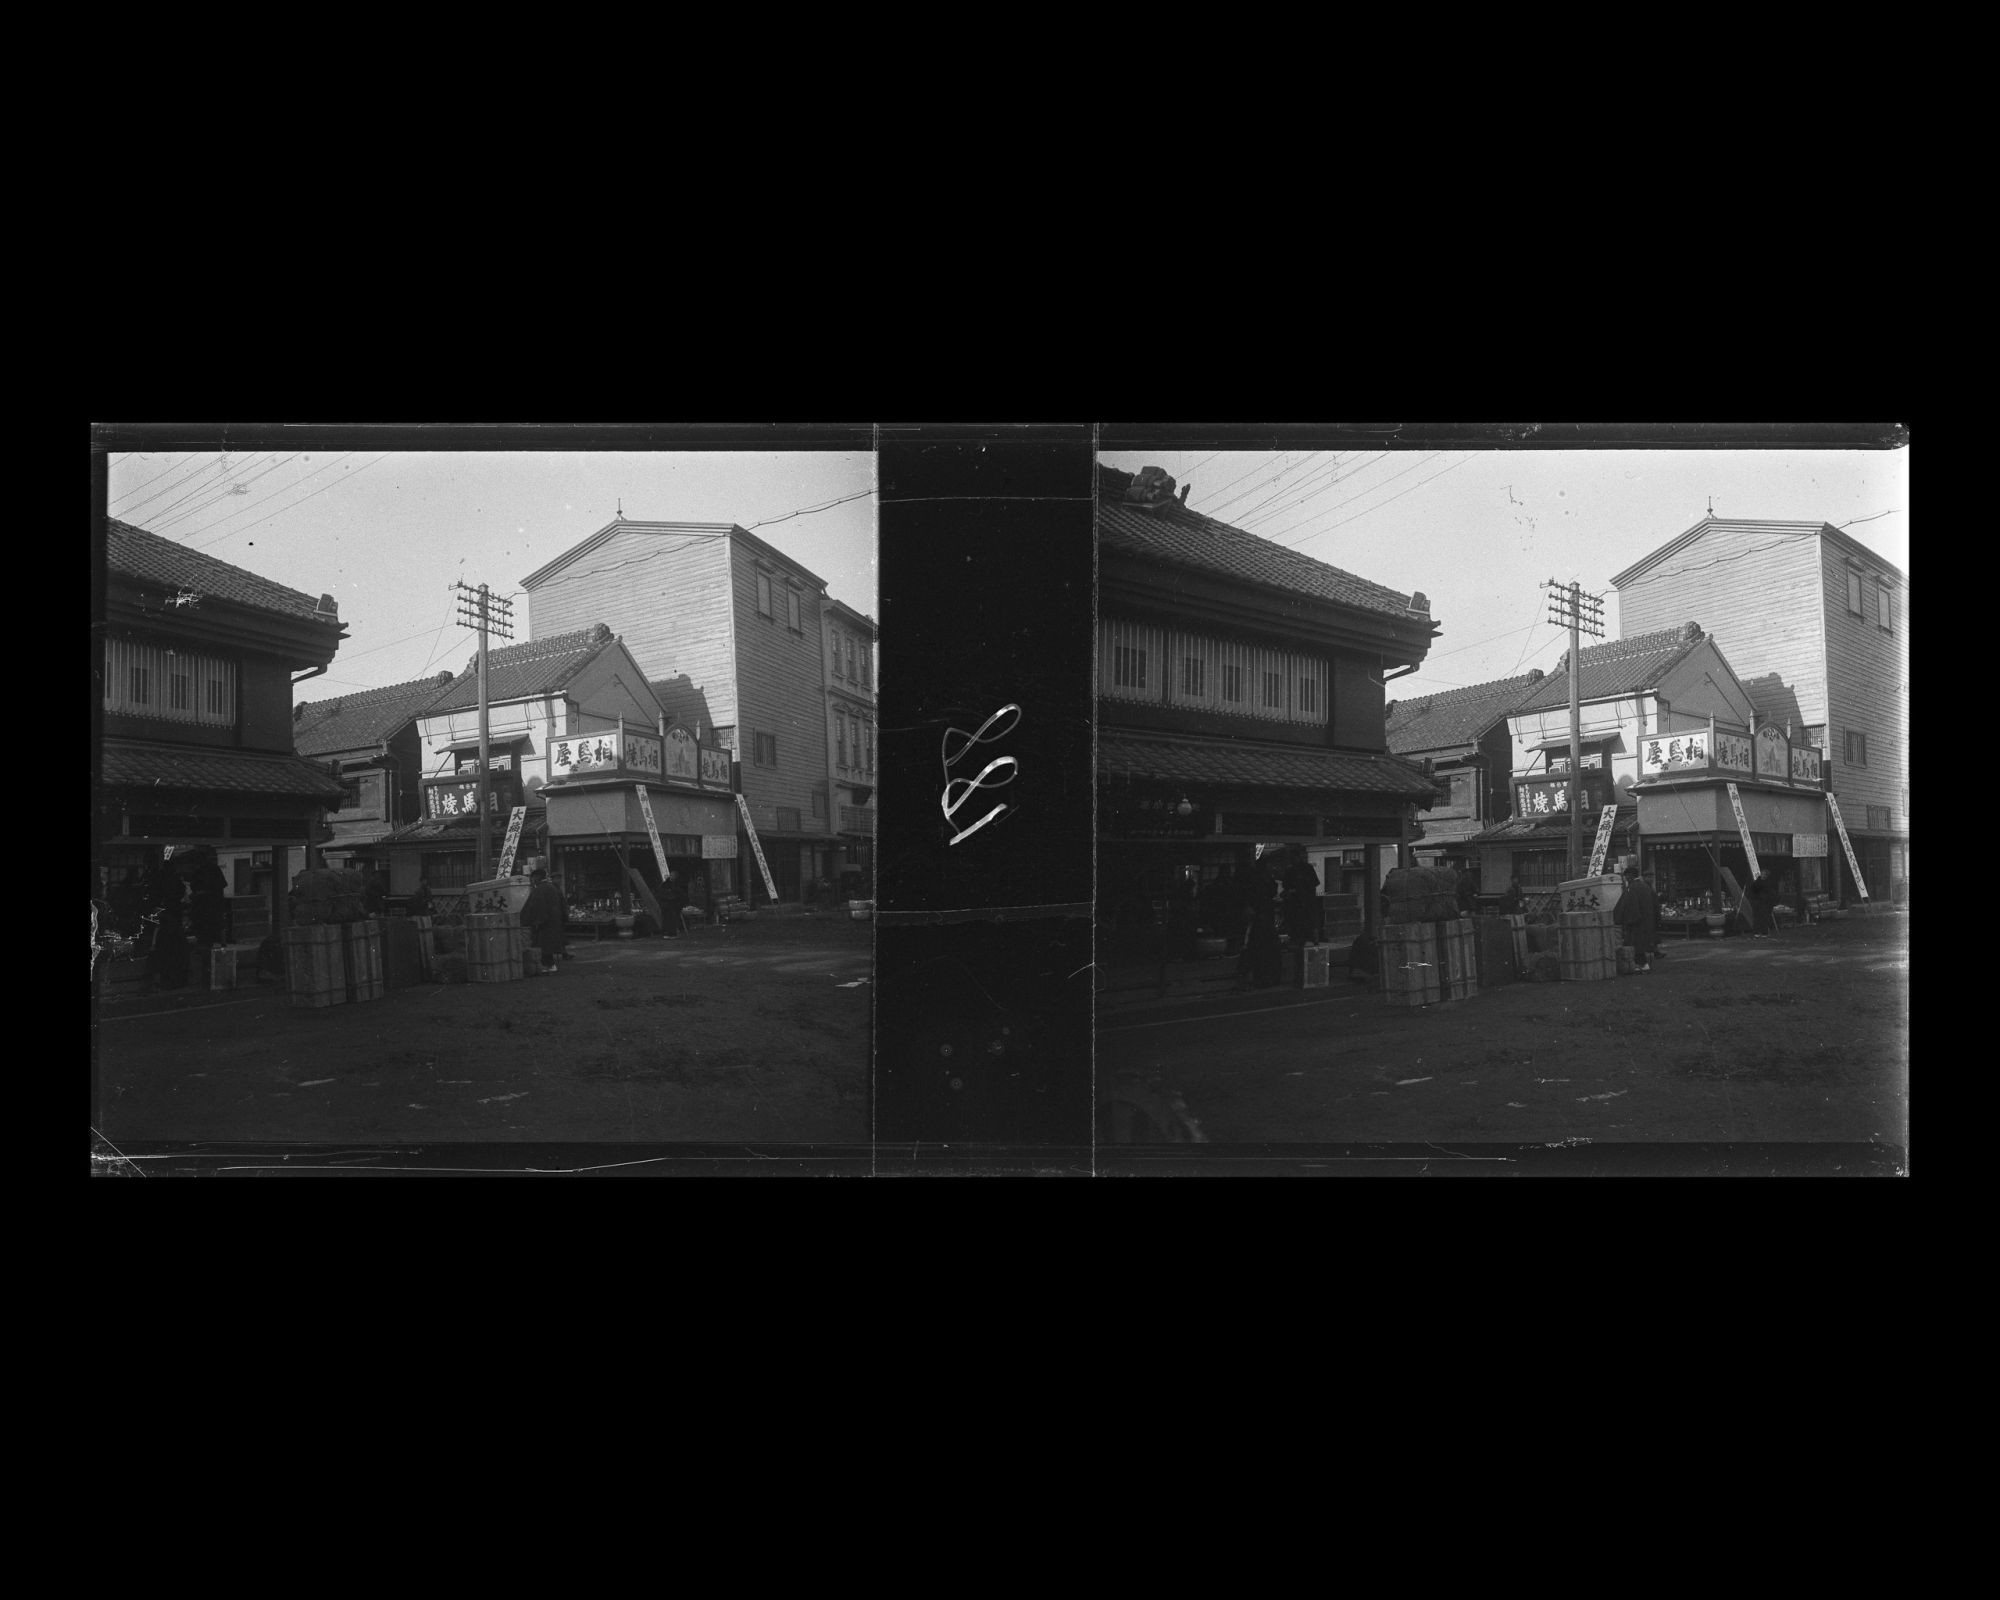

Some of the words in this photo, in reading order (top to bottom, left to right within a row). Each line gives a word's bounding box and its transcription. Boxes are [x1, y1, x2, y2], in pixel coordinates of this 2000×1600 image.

[555, 739, 613, 766] 相馬屋
[1646, 737, 1704, 765] 相馬屋
